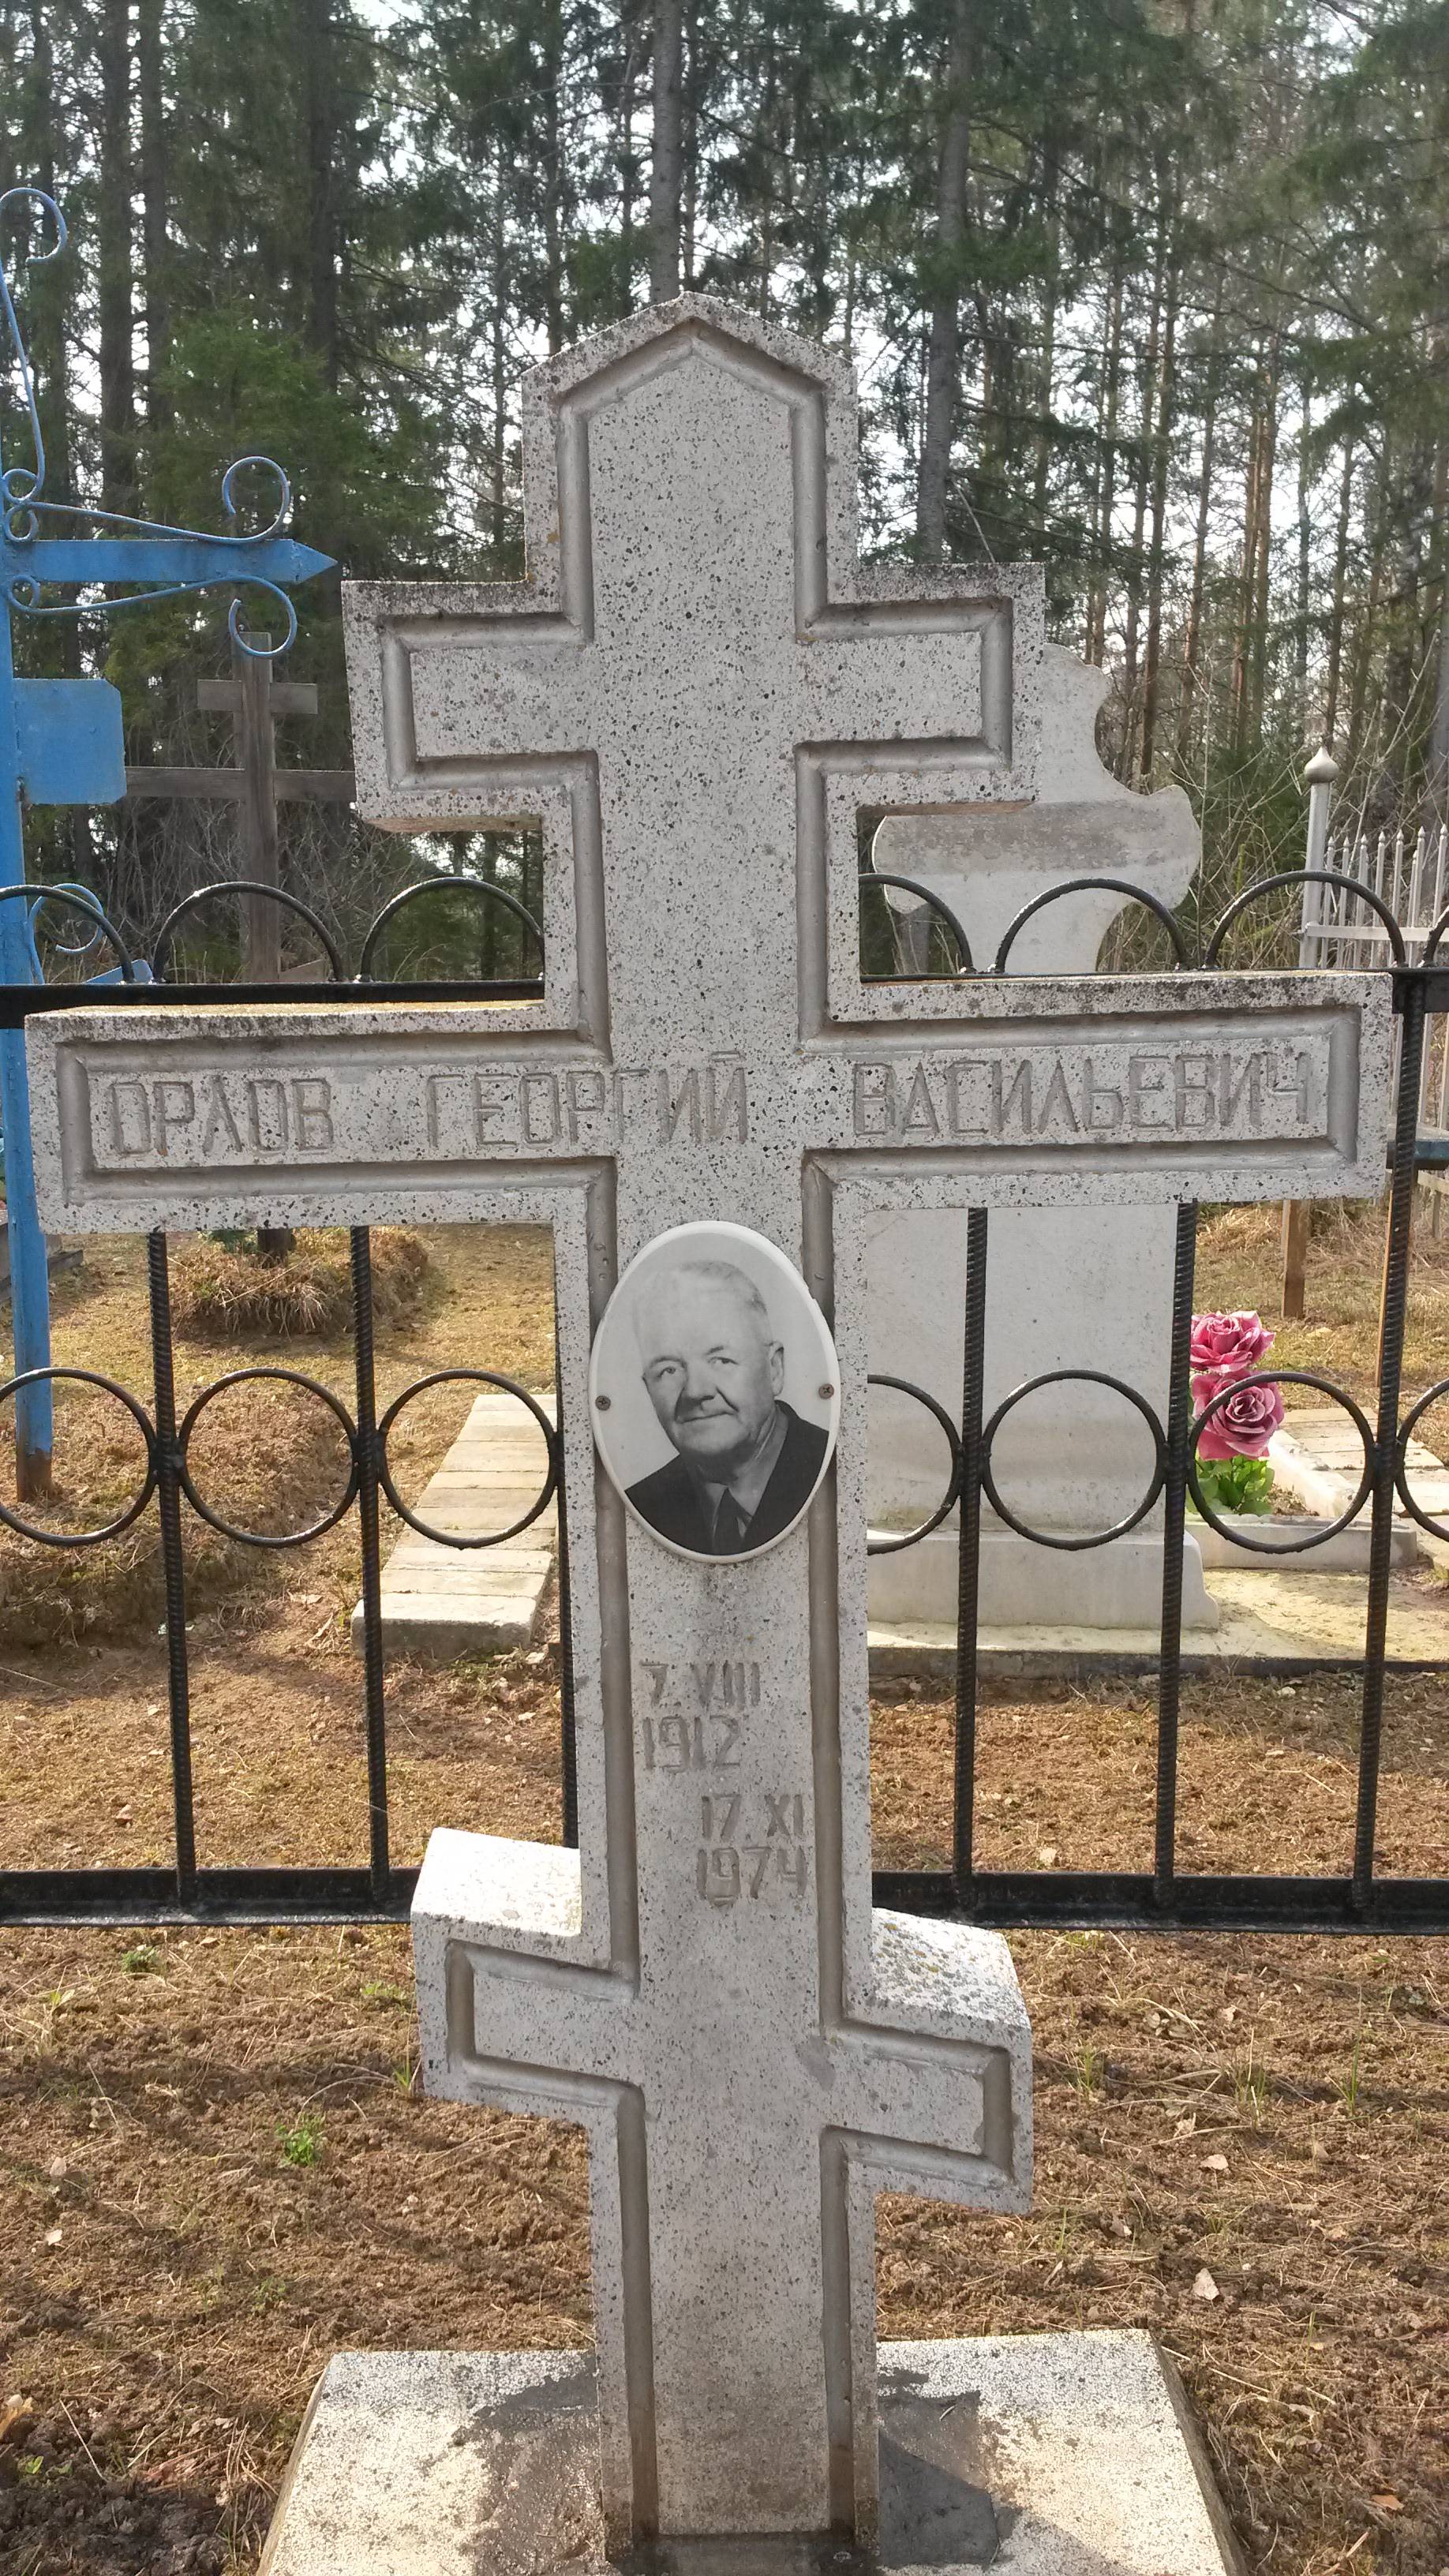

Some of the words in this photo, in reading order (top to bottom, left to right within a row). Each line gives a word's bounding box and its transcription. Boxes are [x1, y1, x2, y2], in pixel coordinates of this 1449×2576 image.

[111, 1076, 334, 1156] ОРЛОВ
[427, 1050, 749, 1149] ГЕОРГИЙ
[853, 1050, 1309, 1137] ВАСИЛЬЕВИЧ
[638, 1661, 669, 1706] 7
[642, 1715, 742, 1773] 1912
[700, 1792, 742, 1841] 17
[764, 1793, 804, 1838] XI
[695, 1844, 808, 1907] 1974
